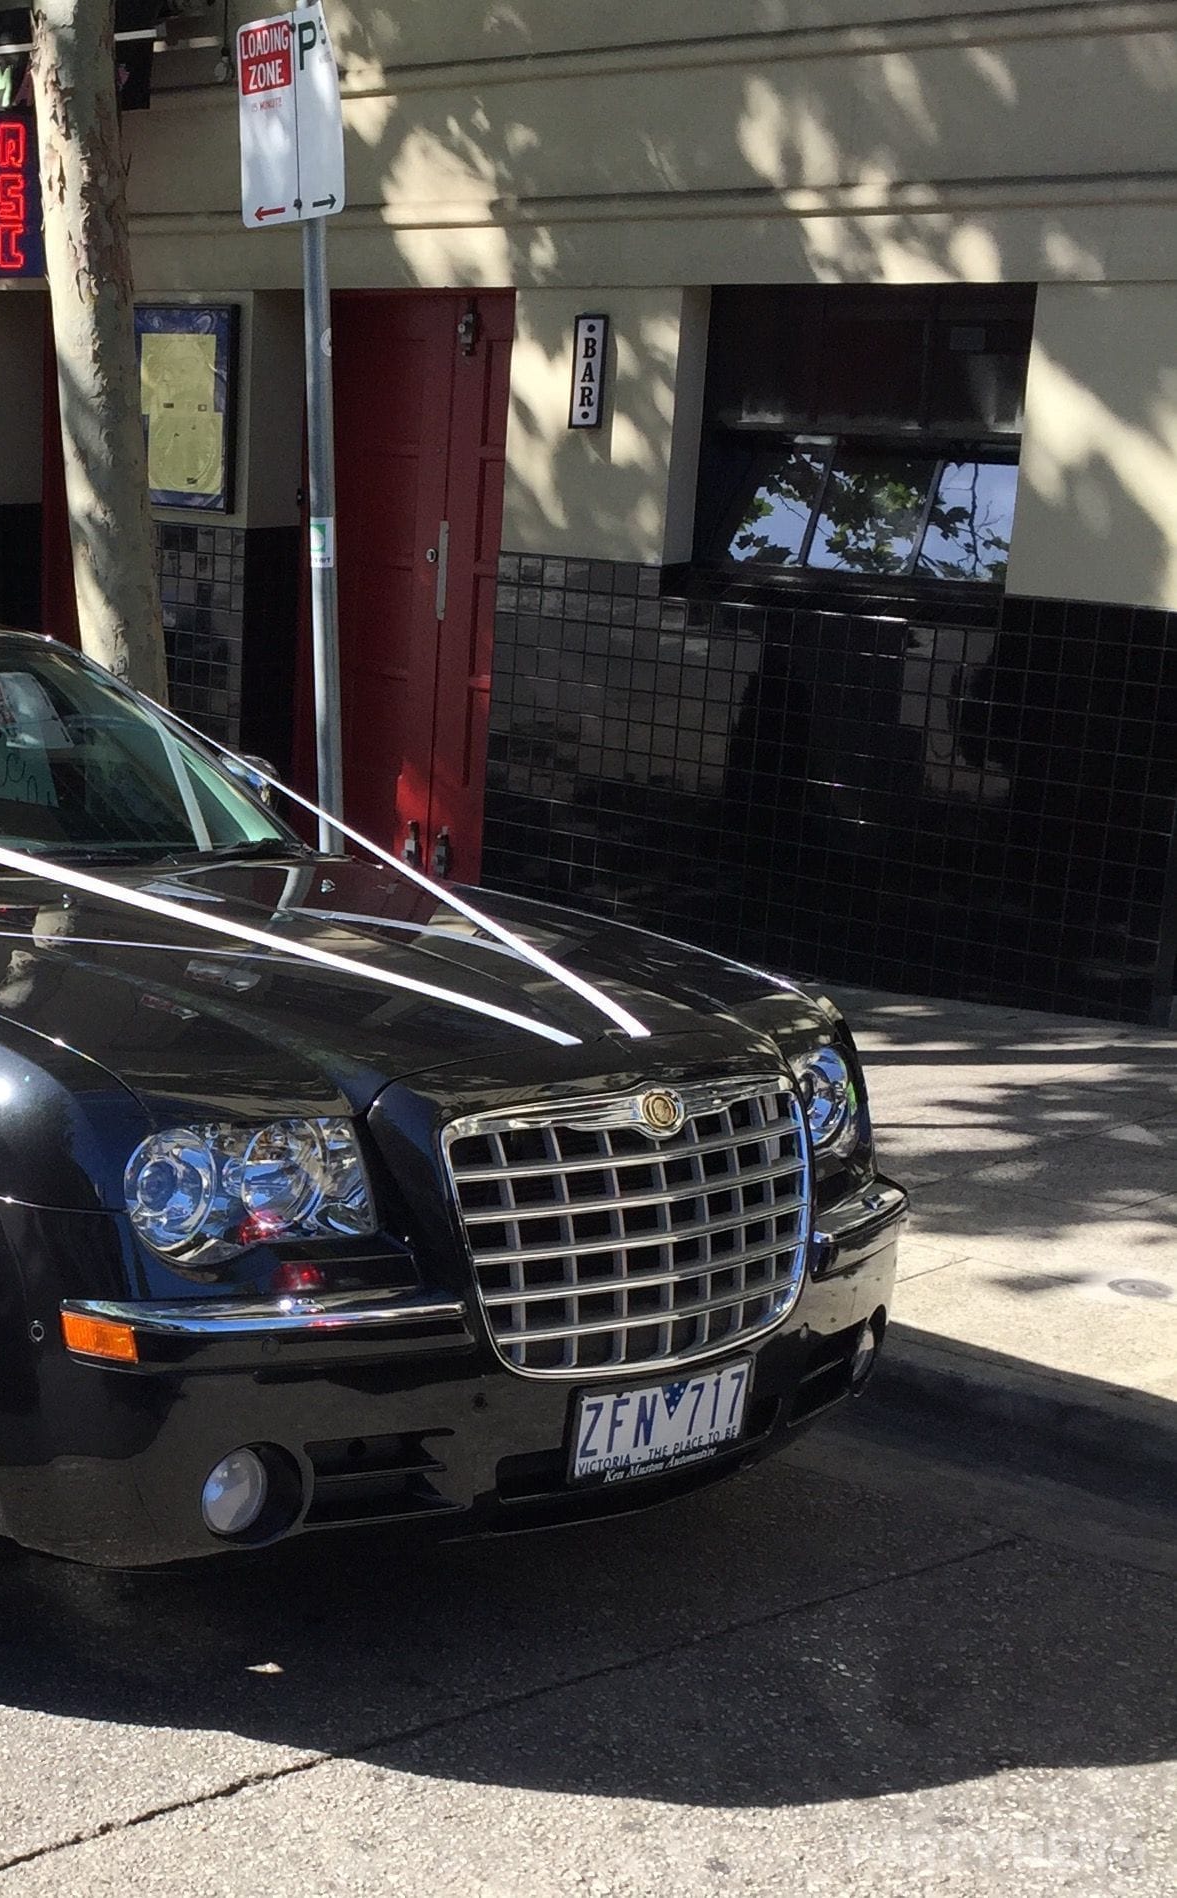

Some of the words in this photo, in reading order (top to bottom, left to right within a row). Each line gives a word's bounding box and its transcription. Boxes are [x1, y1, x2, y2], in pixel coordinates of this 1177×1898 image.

[241, 25, 289, 60] LOADING
[248, 59, 285, 90] ZONE
[578, 337, 598, 408] BAR
[579, 1393, 659, 1459] ZFN
[686, 1370, 746, 1437] 717
[578, 1453, 631, 1475] VICTORIA
[648, 1444, 669, 1461] THE
[672, 1435, 704, 1456] PLACE
[708, 1430, 721, 1445] TO
[725, 1425, 738, 1441] BE
[603, 1467, 625, 1484] Ken
